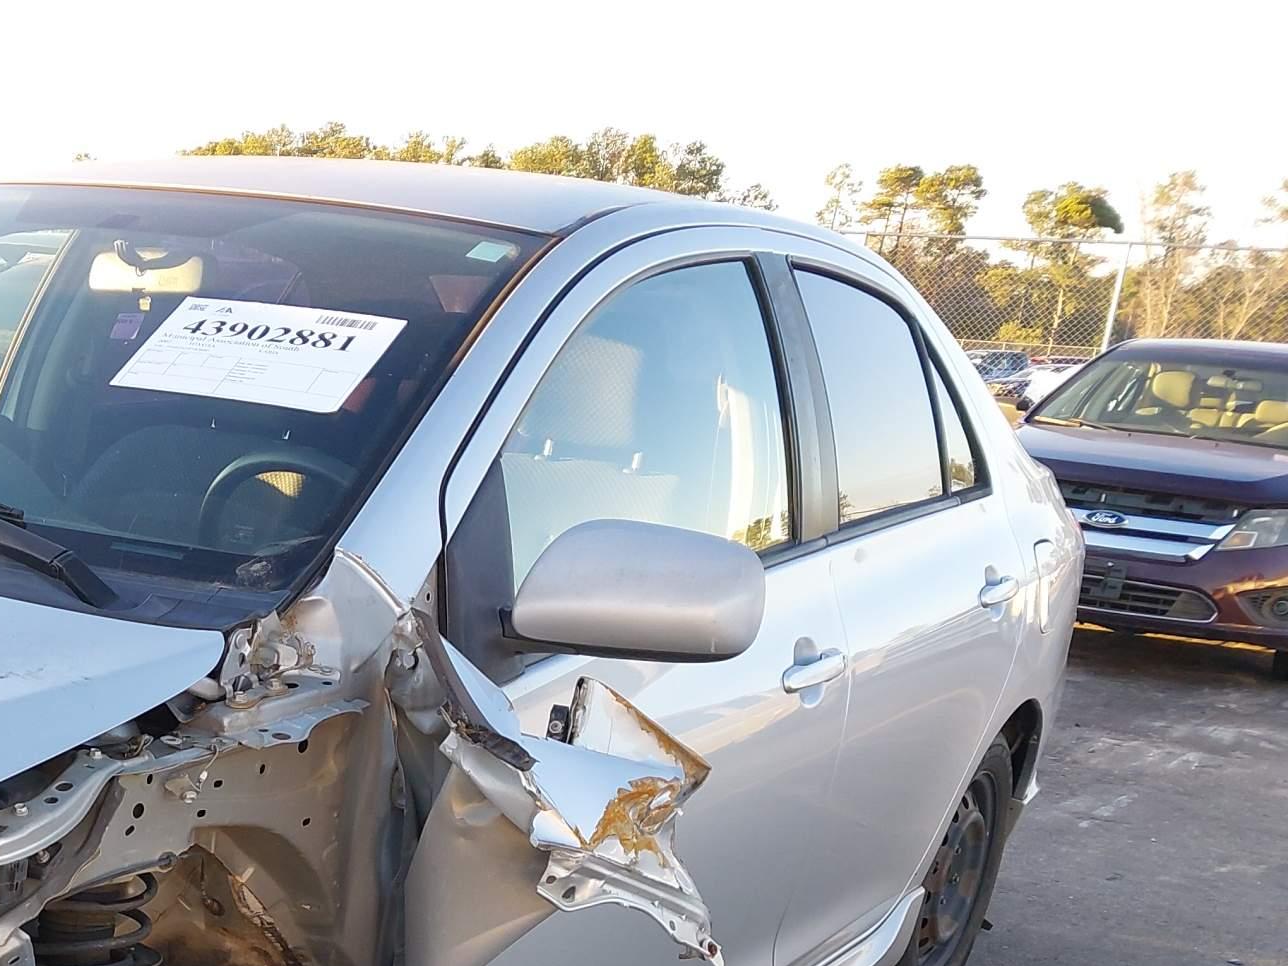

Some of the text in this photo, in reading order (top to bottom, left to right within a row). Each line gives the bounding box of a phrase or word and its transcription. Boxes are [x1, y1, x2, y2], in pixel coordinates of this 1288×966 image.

[183, 318, 358, 353] 43902881
[272, 343, 300, 352] South
[1090, 510, 1119, 523] Ford
